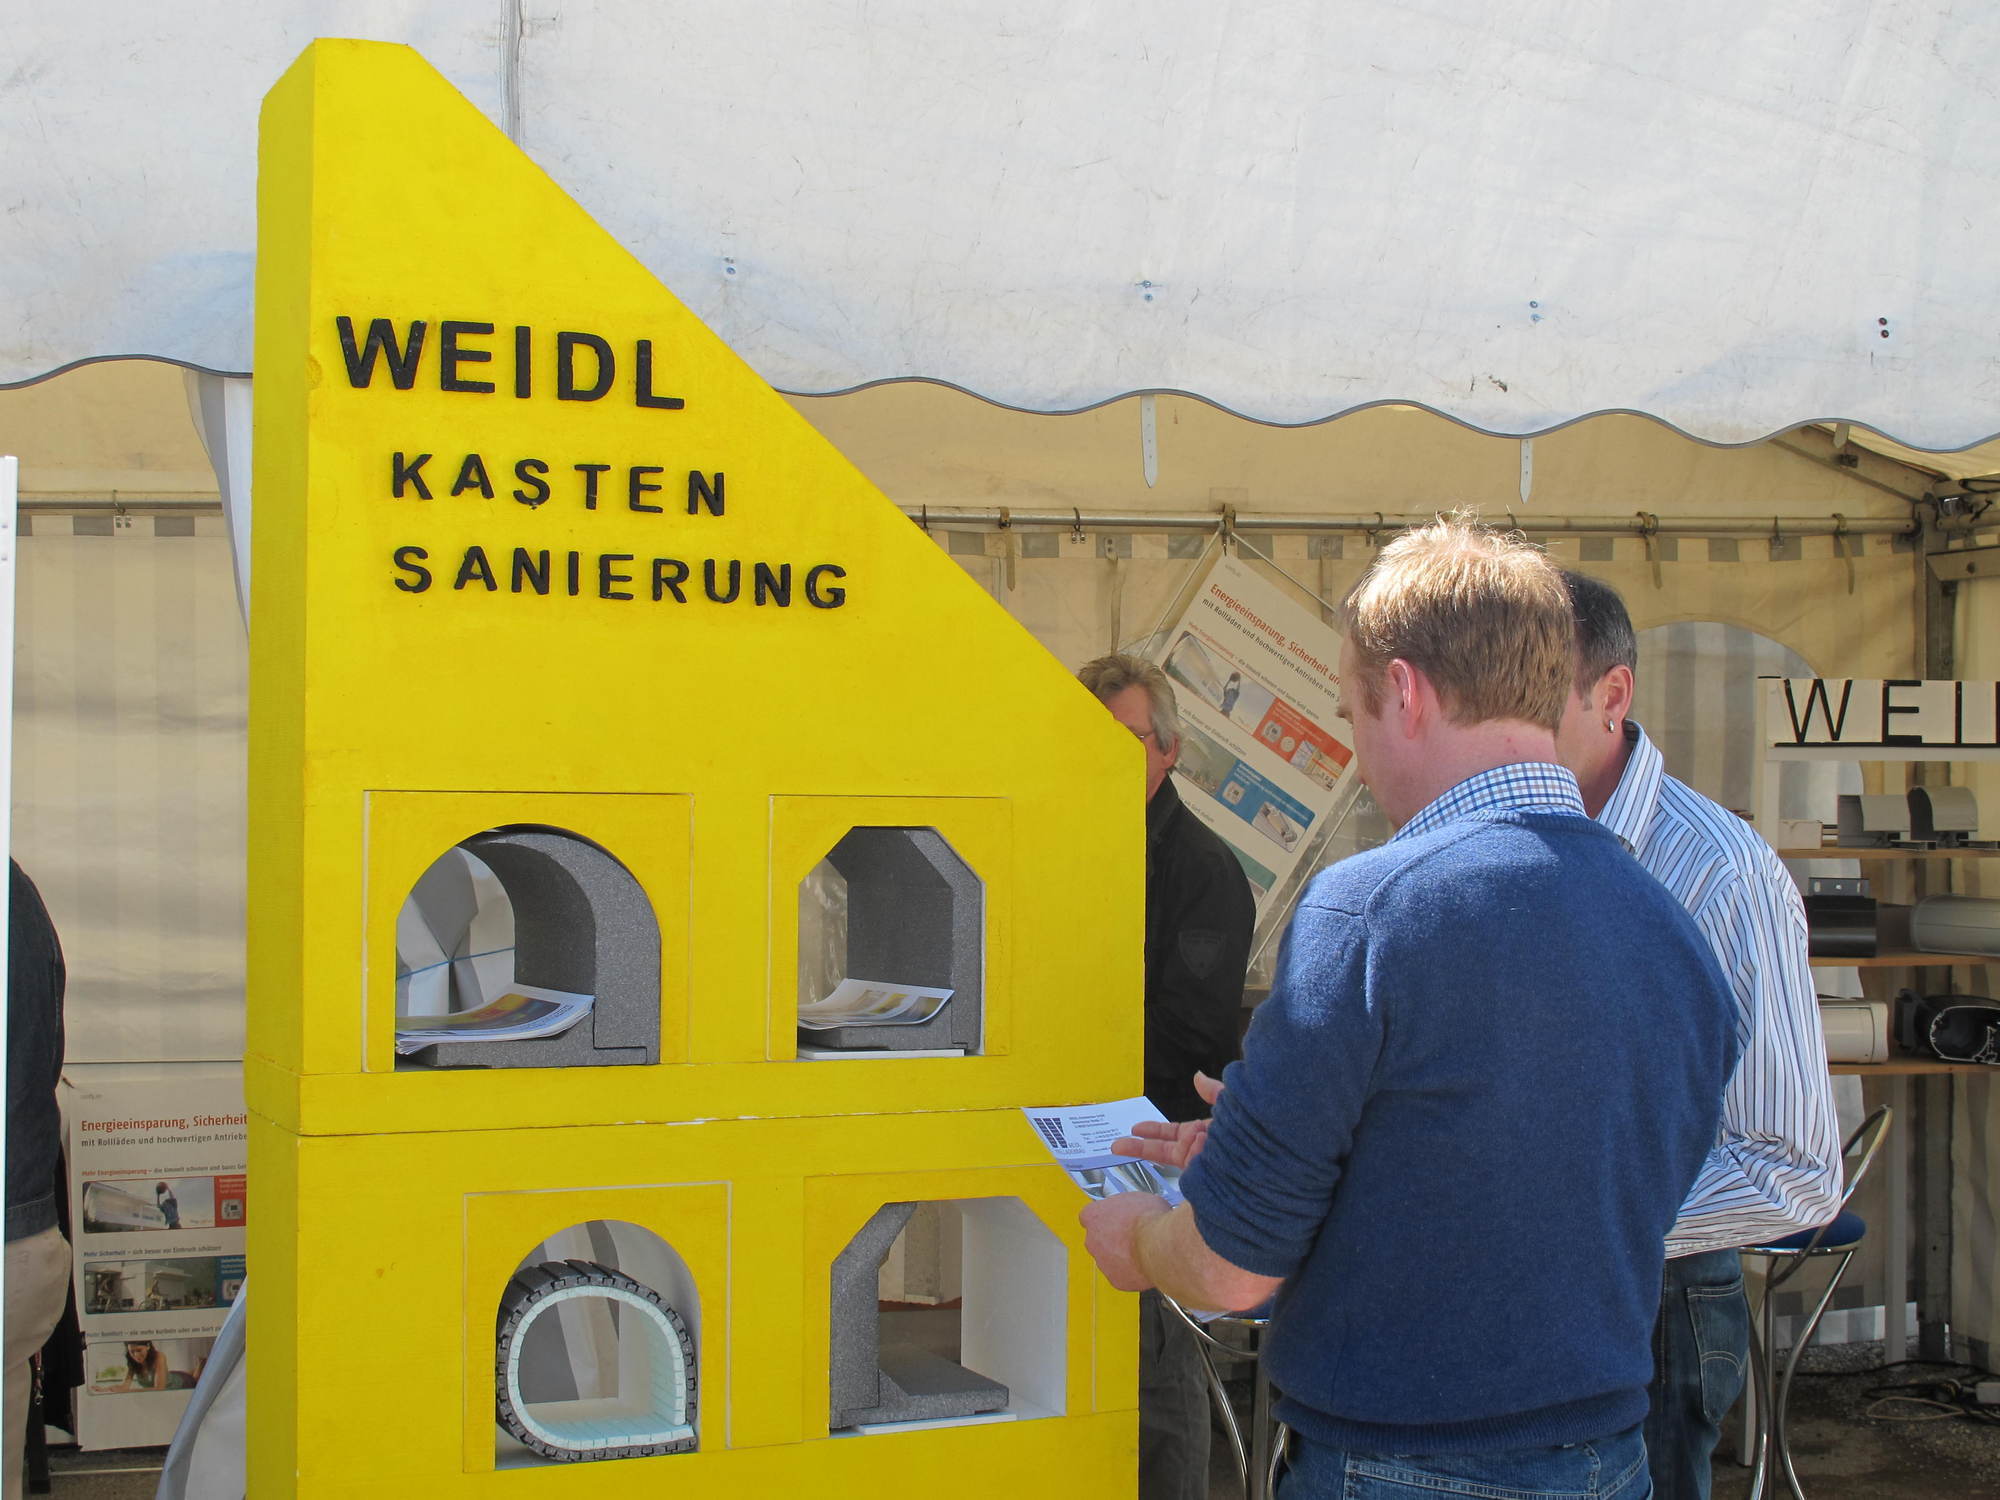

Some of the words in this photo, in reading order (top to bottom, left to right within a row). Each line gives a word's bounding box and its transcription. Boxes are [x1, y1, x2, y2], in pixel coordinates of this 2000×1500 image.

[336, 316, 685, 410] WEIDL
[392, 451, 725, 517] KASTEN
[393, 545, 848, 609] SANIERUNG
[1202, 598, 1214, 610] mit
[1242, 626, 1255, 639] und
[1255, 635, 1295, 670] hochwertigen
[1294, 666, 1323, 691] Antrieben
[1323, 688, 1336, 699] von
[1210, 584, 1286, 648] Energieeinsparung,
[1287, 641, 1329, 676] Sicherheit
[1784, 679, 2000, 746] WEI
[81, 1117, 190, 1133] Energieeinsparung,
[193, 1113, 248, 1127] Sicherheit
[81, 1138, 95, 1147] mit
[98, 1136, 136, 1147] Rollläden
[138, 1135, 154, 1145] und
[156, 1133, 212, 1144] hochwertigen
